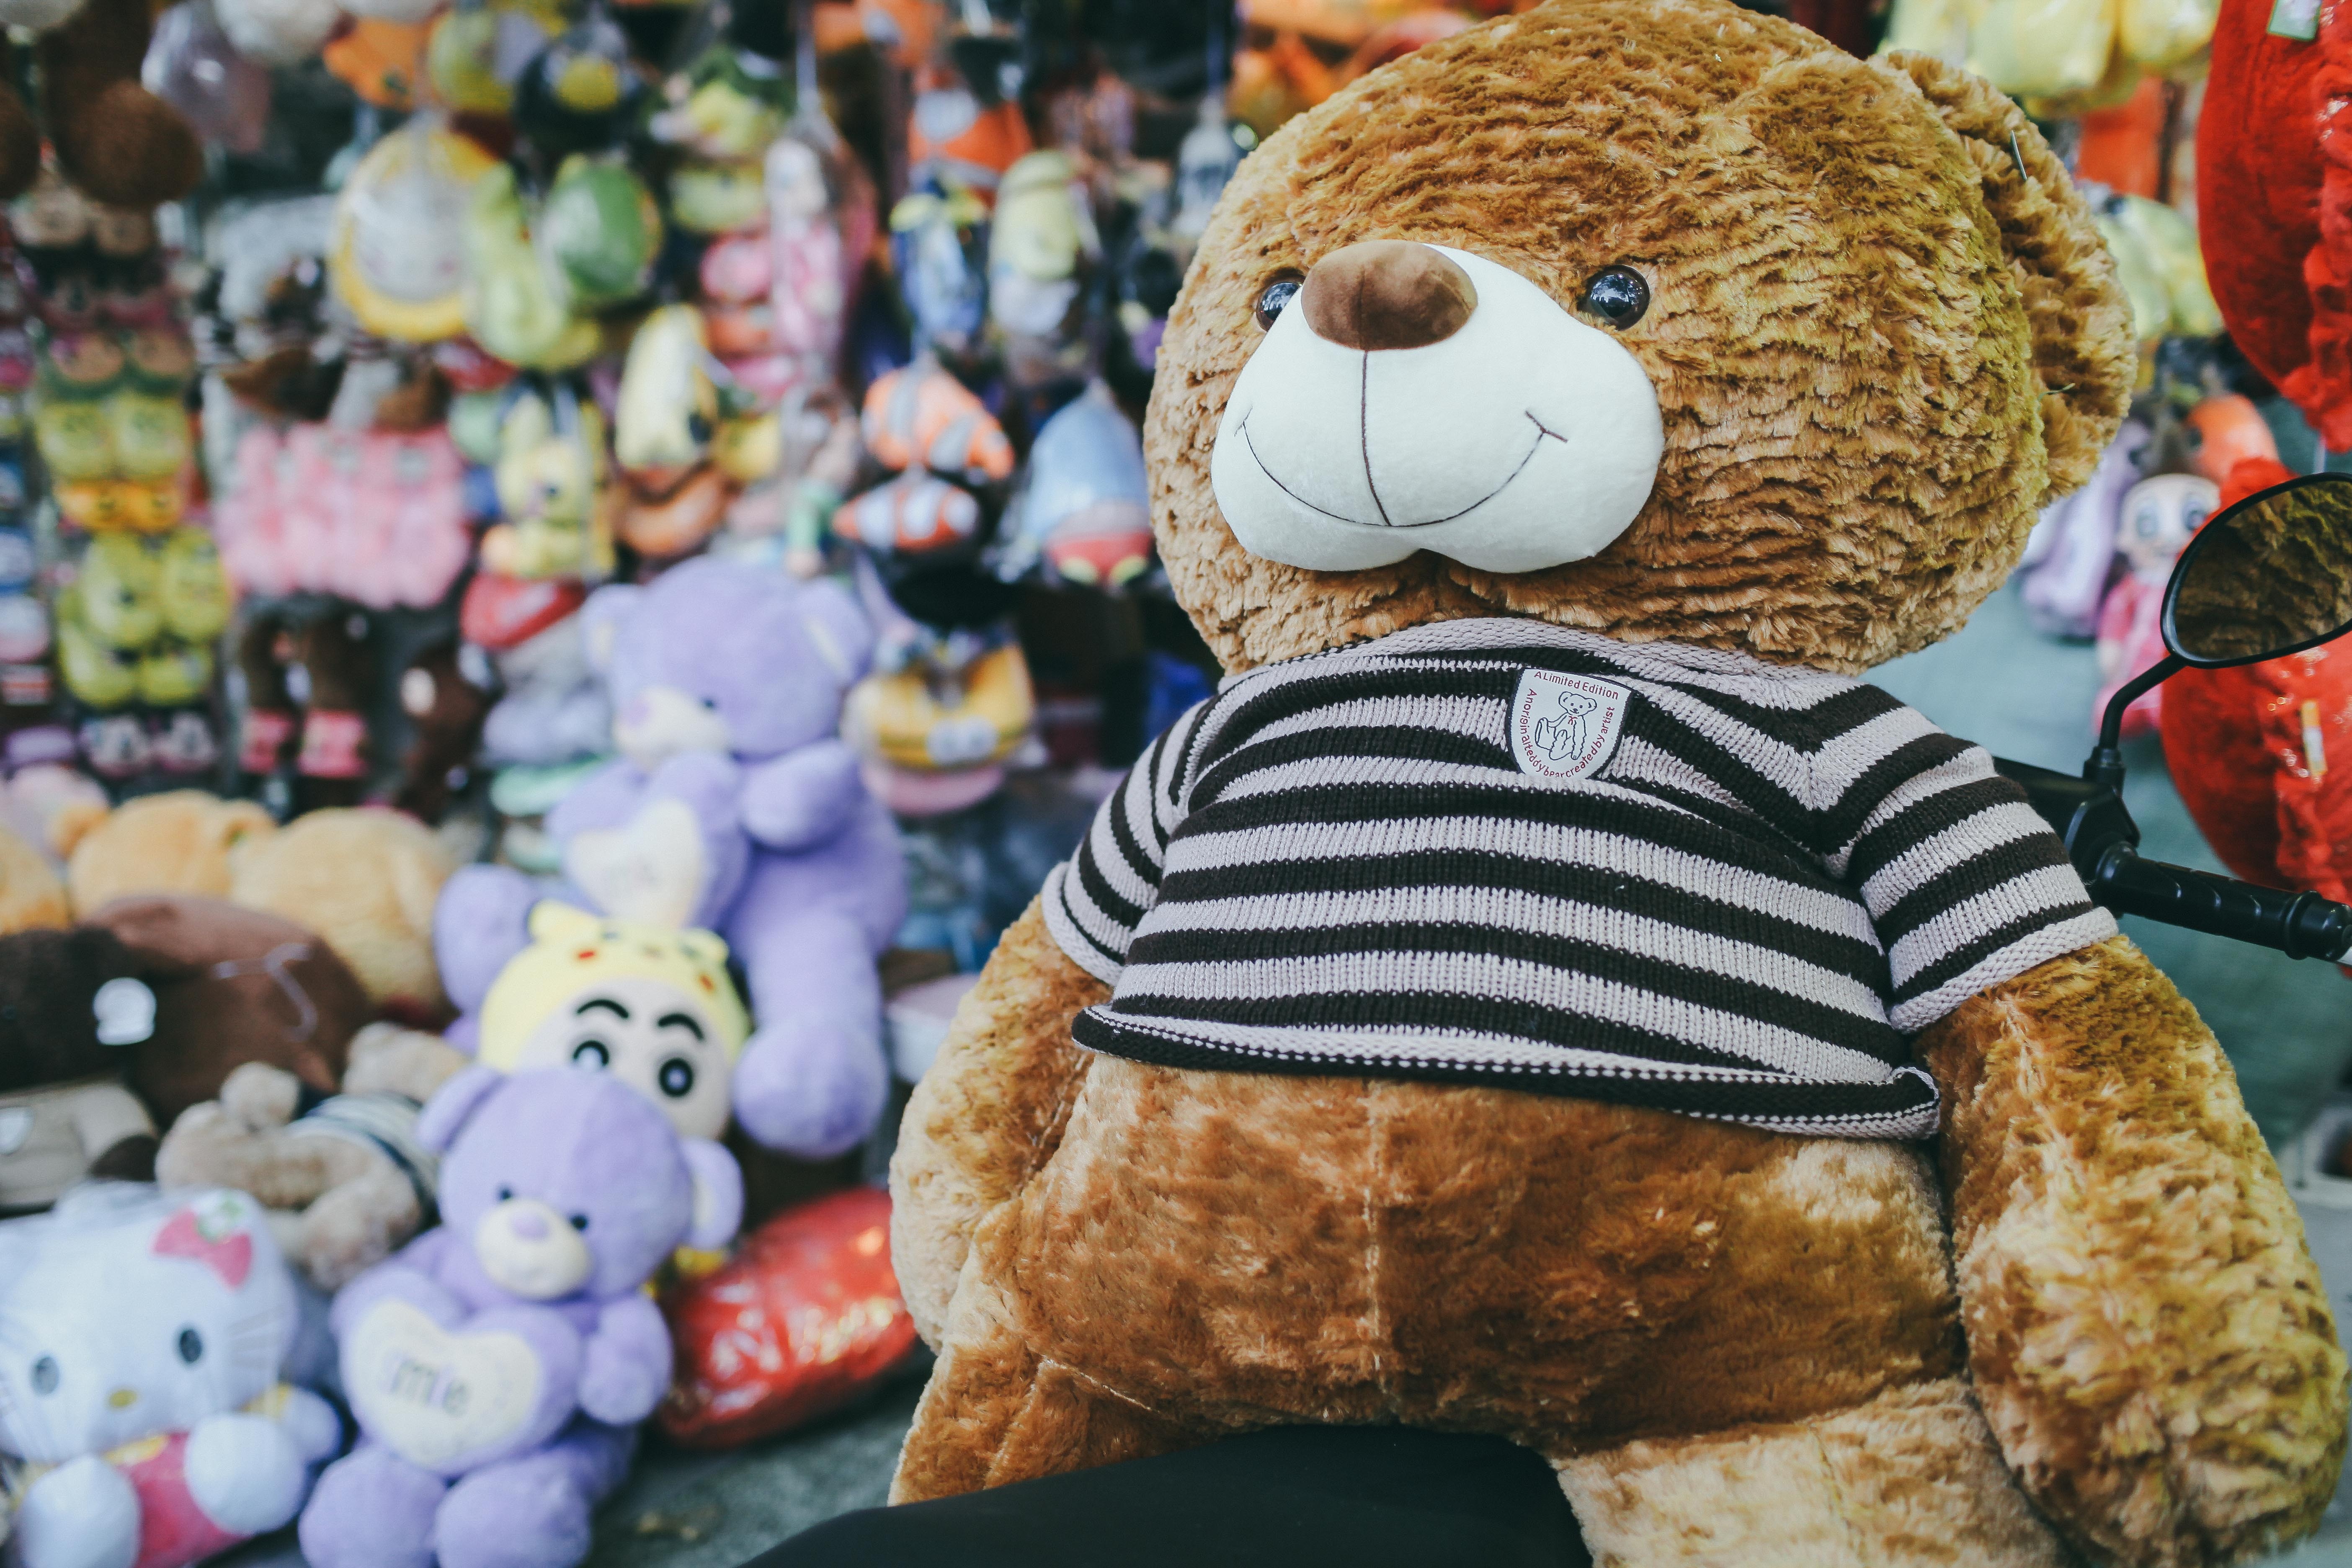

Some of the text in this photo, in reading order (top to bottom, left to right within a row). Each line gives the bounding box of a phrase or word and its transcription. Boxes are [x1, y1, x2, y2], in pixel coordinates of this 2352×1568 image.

[1582, 682, 1619, 700] Edition
[1592, 734, 1605, 748] by
[1601, 707, 1615, 734] artist
